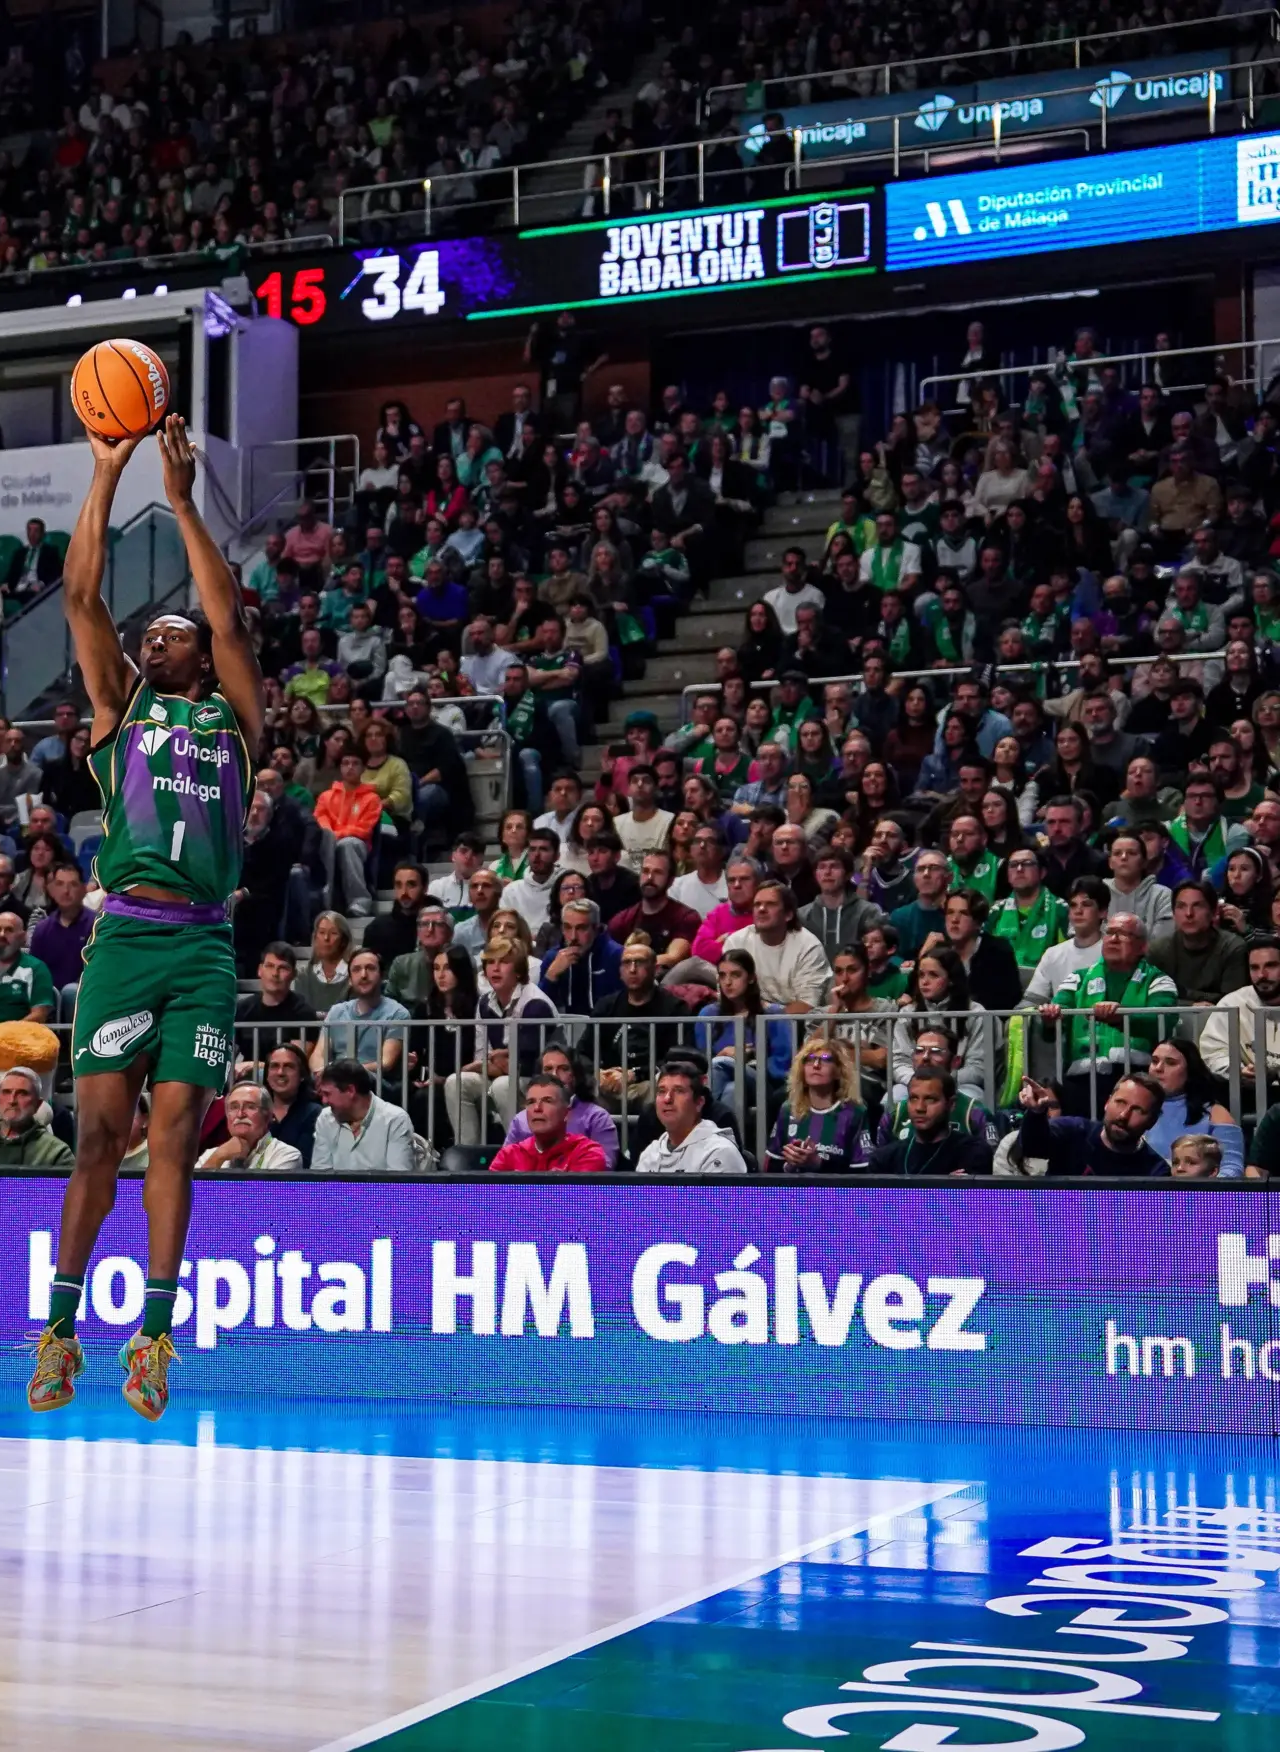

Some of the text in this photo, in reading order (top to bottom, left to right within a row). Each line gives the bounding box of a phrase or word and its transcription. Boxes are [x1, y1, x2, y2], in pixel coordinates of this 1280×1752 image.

[1135, 74, 1223, 102] Unicaja
[957, 98, 1043, 124] Uncaja
[978, 172, 1163, 213] Diputación Provincial
[602, 209, 765, 262] JOVENTUT
[978, 208, 1068, 232] de Málaga
[361, 250, 446, 320] 34
[599, 244, 765, 296] BADALONA
[256, 268, 326, 326] 15
[132, 345, 165, 410] Wilson
[82, 390, 96, 417] acb
[1, 494, 19, 508] de
[174, 737, 230, 768] Uncaja
[170, 820, 186, 862] 1
[98, 1012, 151, 1053] famadesa
[195, 1032, 227, 1051] a má
[196, 1023, 221, 1035] sabor
[193, 1041, 225, 1067] laga
[432, 1239, 596, 1338] HM
[631, 1243, 986, 1351] Gálvez
[1104, 1319, 1195, 1379] hm
[736, 1504, 1280, 1752] #ligaende
